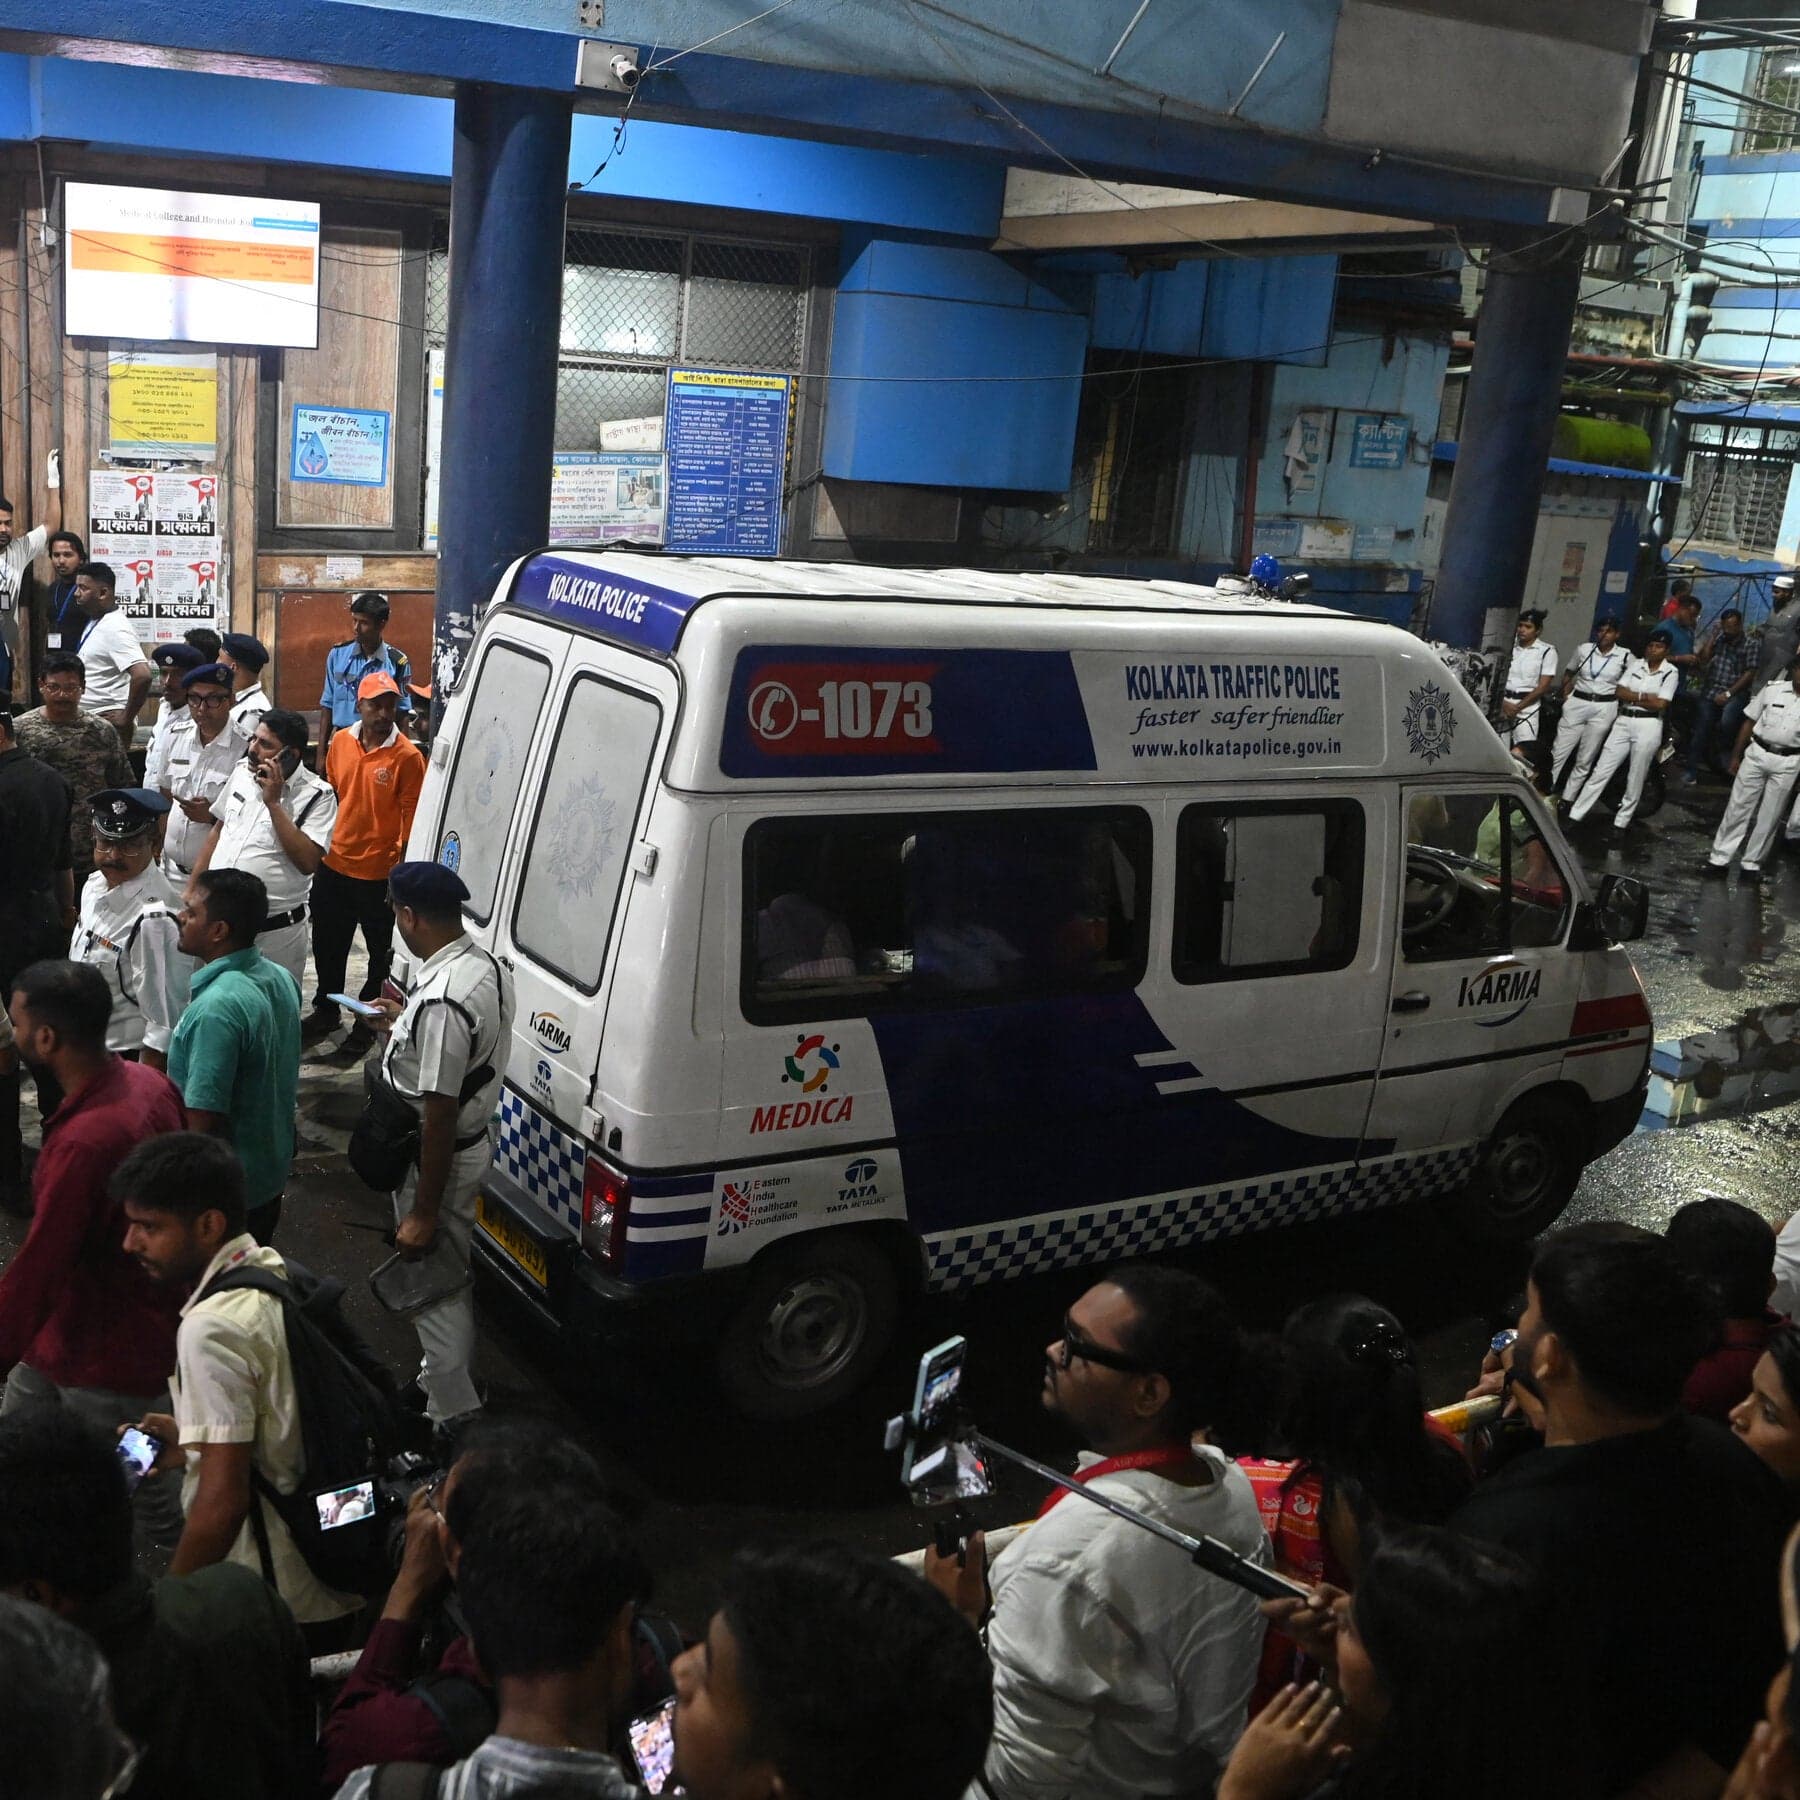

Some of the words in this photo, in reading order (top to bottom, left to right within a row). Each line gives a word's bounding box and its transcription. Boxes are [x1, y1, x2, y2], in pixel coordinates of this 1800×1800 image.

[153, 211, 180, 223] College
[181, 213, 200, 223] and
[96, 519, 149, 533] সম্মেলন
[160, 521, 211, 535] সম্মেলন
[547, 573, 602, 612] KOLKATA
[598, 584, 650, 624] POLICE
[160, 604, 211, 618] সম্মেলন
[1125, 665, 1209, 701] KOLKATA
[1211, 665, 1282, 700] TRAFFIC
[1285, 666, 1341, 700] POLICE
[1129, 706, 1201, 735] faster
[1211, 705, 1269, 731] safer
[1268, 706, 1344, 732] friendlier
[1132, 738, 1342, 759] www.kolkatapolice.gov.in
[446, 849, 455, 868] 13
[1458, 968, 1542, 1008] KARMA
[529, 1011, 571, 1052] KARMA
[534, 1075, 552, 1095] TATA
[750, 1095, 854, 1134] MEDICA
[753, 1176, 791, 1190] Eastern
[752, 1191, 776, 1204] India
[838, 1184, 878, 1200] TATA
[751, 1200, 798, 1217] Healthcare
[826, 1203, 849, 1213] TATA
[749, 1211, 798, 1228] Foundation
